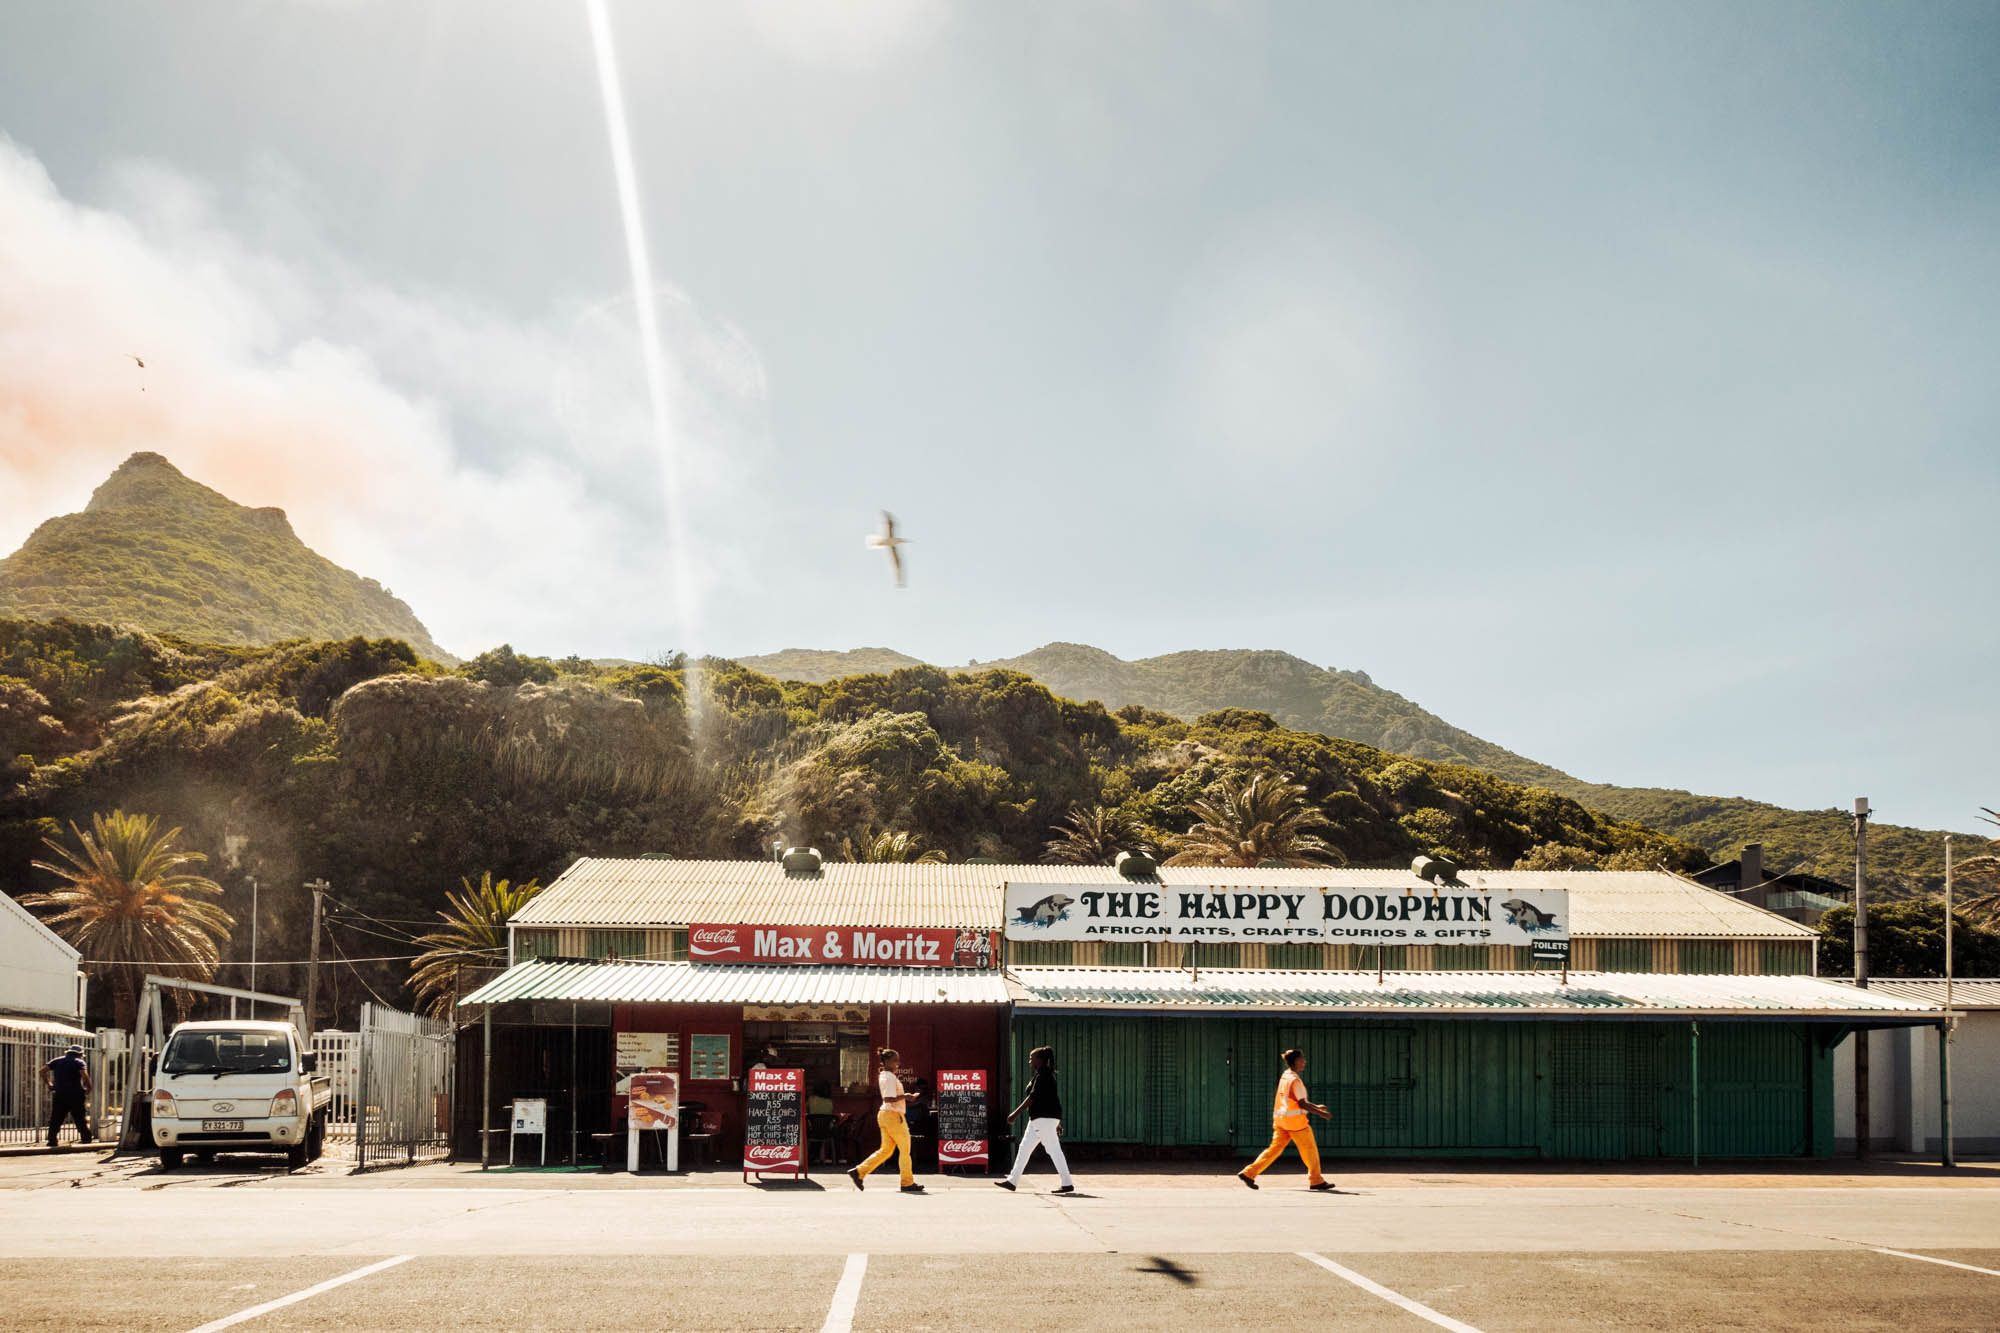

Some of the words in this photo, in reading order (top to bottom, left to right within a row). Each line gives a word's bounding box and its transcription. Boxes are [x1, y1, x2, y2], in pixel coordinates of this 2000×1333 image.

[1081, 891, 1160, 919] THE
[1178, 893, 1306, 921] HAPPY
[1323, 894, 1492, 922] DOLPHIN
[693, 928, 737, 943] Coca-Cola
[1085, 925, 1171, 935] AFRICAN
[1179, 927, 1235, 937] ARTS,
[1242, 927, 1325, 938] CRAFTS,
[1331, 928, 1407, 938] CURIOS
[1414, 928, 1429, 938] &
[1435, 929, 1491, 938] GIFTS
[754, 929, 813, 958] Max
[823, 931, 843, 959] &
[853, 931, 940, 961] Moritz
[1533, 941, 1569, 952] TOILETS
[754, 1071, 782, 1081] Max
[786, 1071, 797, 1081] &
[943, 1072, 968, 1081] Max
[971, 1072, 981, 1081] &
[754, 1082, 797, 1091] Moritz
[943, 1082, 982, 1091] Moritz
[749, 1145, 794, 1159] Coca-Cola
[943, 1140, 984, 1153] Coca-Cola
